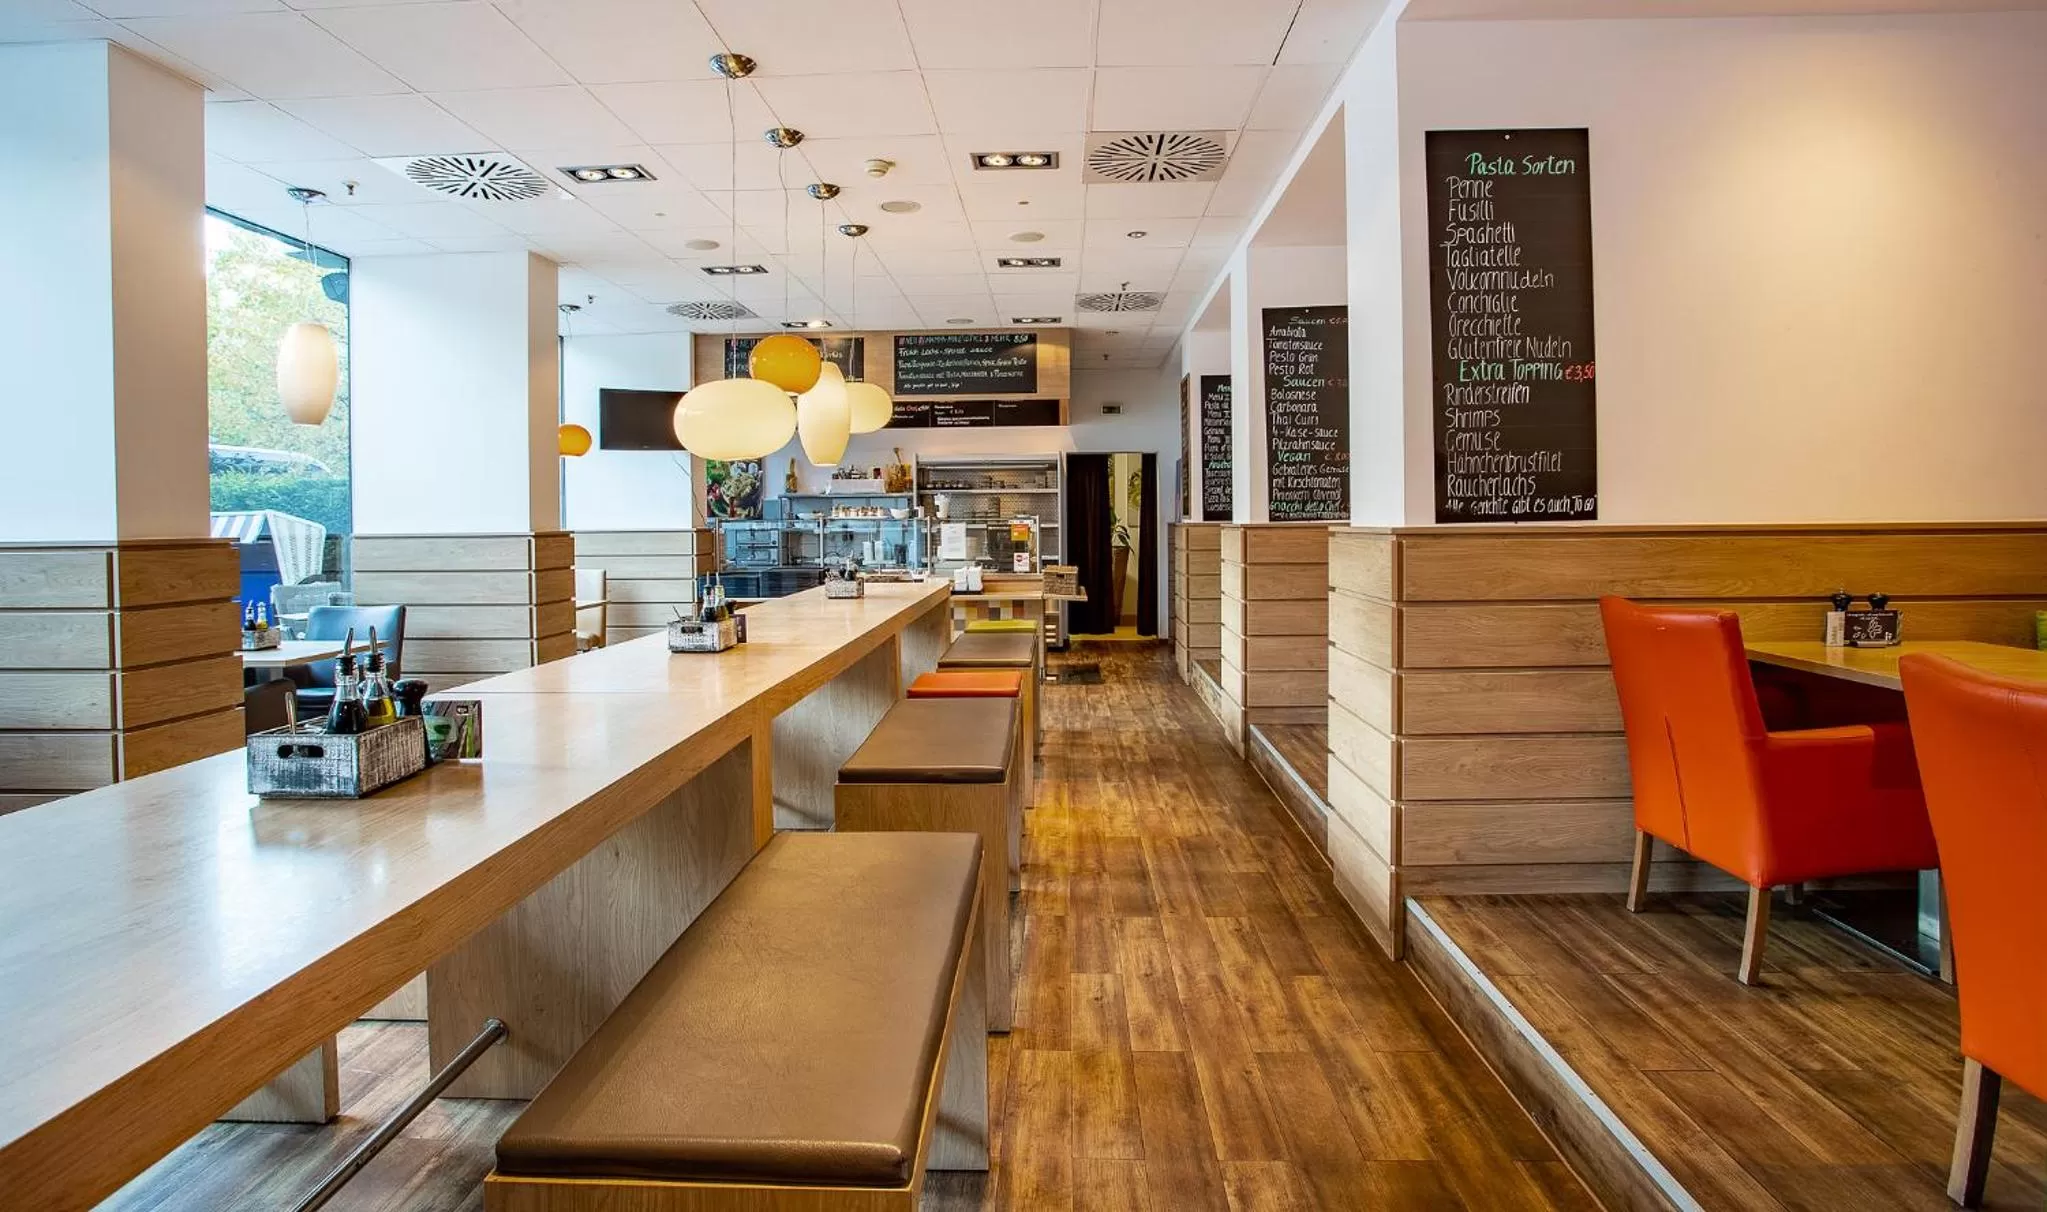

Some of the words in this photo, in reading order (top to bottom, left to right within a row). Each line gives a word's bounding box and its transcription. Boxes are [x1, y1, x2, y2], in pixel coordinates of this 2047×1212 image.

[1465, 152, 1516, 175] Pasta
[1522, 155, 1576, 175] Sorten
[1446, 176, 1494, 198] Penne
[1448, 199, 1494, 221] Fusilli
[1445, 222, 1515, 246] Spaghetti
[1440, 241, 1521, 267] Tagliatelle
[1448, 311, 1521, 337] Orecchiette
[1268, 350, 1296, 363] Pesto
[1447, 336, 1521, 360] Glutenfreie
[1526, 335, 1572, 359] Nudeln
[1268, 362, 1295, 376] Pesto
[1298, 362, 1315, 375] Rot
[1459, 359, 1506, 382] Extra
[1283, 375, 1326, 387] Saucen
[1444, 381, 1530, 405] Rinderstreifen
[1269, 411, 1292, 425] Thai
[1270, 401, 1318, 413] Carbonara
[1445, 408, 1501, 428] Shrimps
[1277, 450, 1311, 462] Vegan
[1533, 497, 1546, 513] es
[1547, 495, 1571, 514] auch
